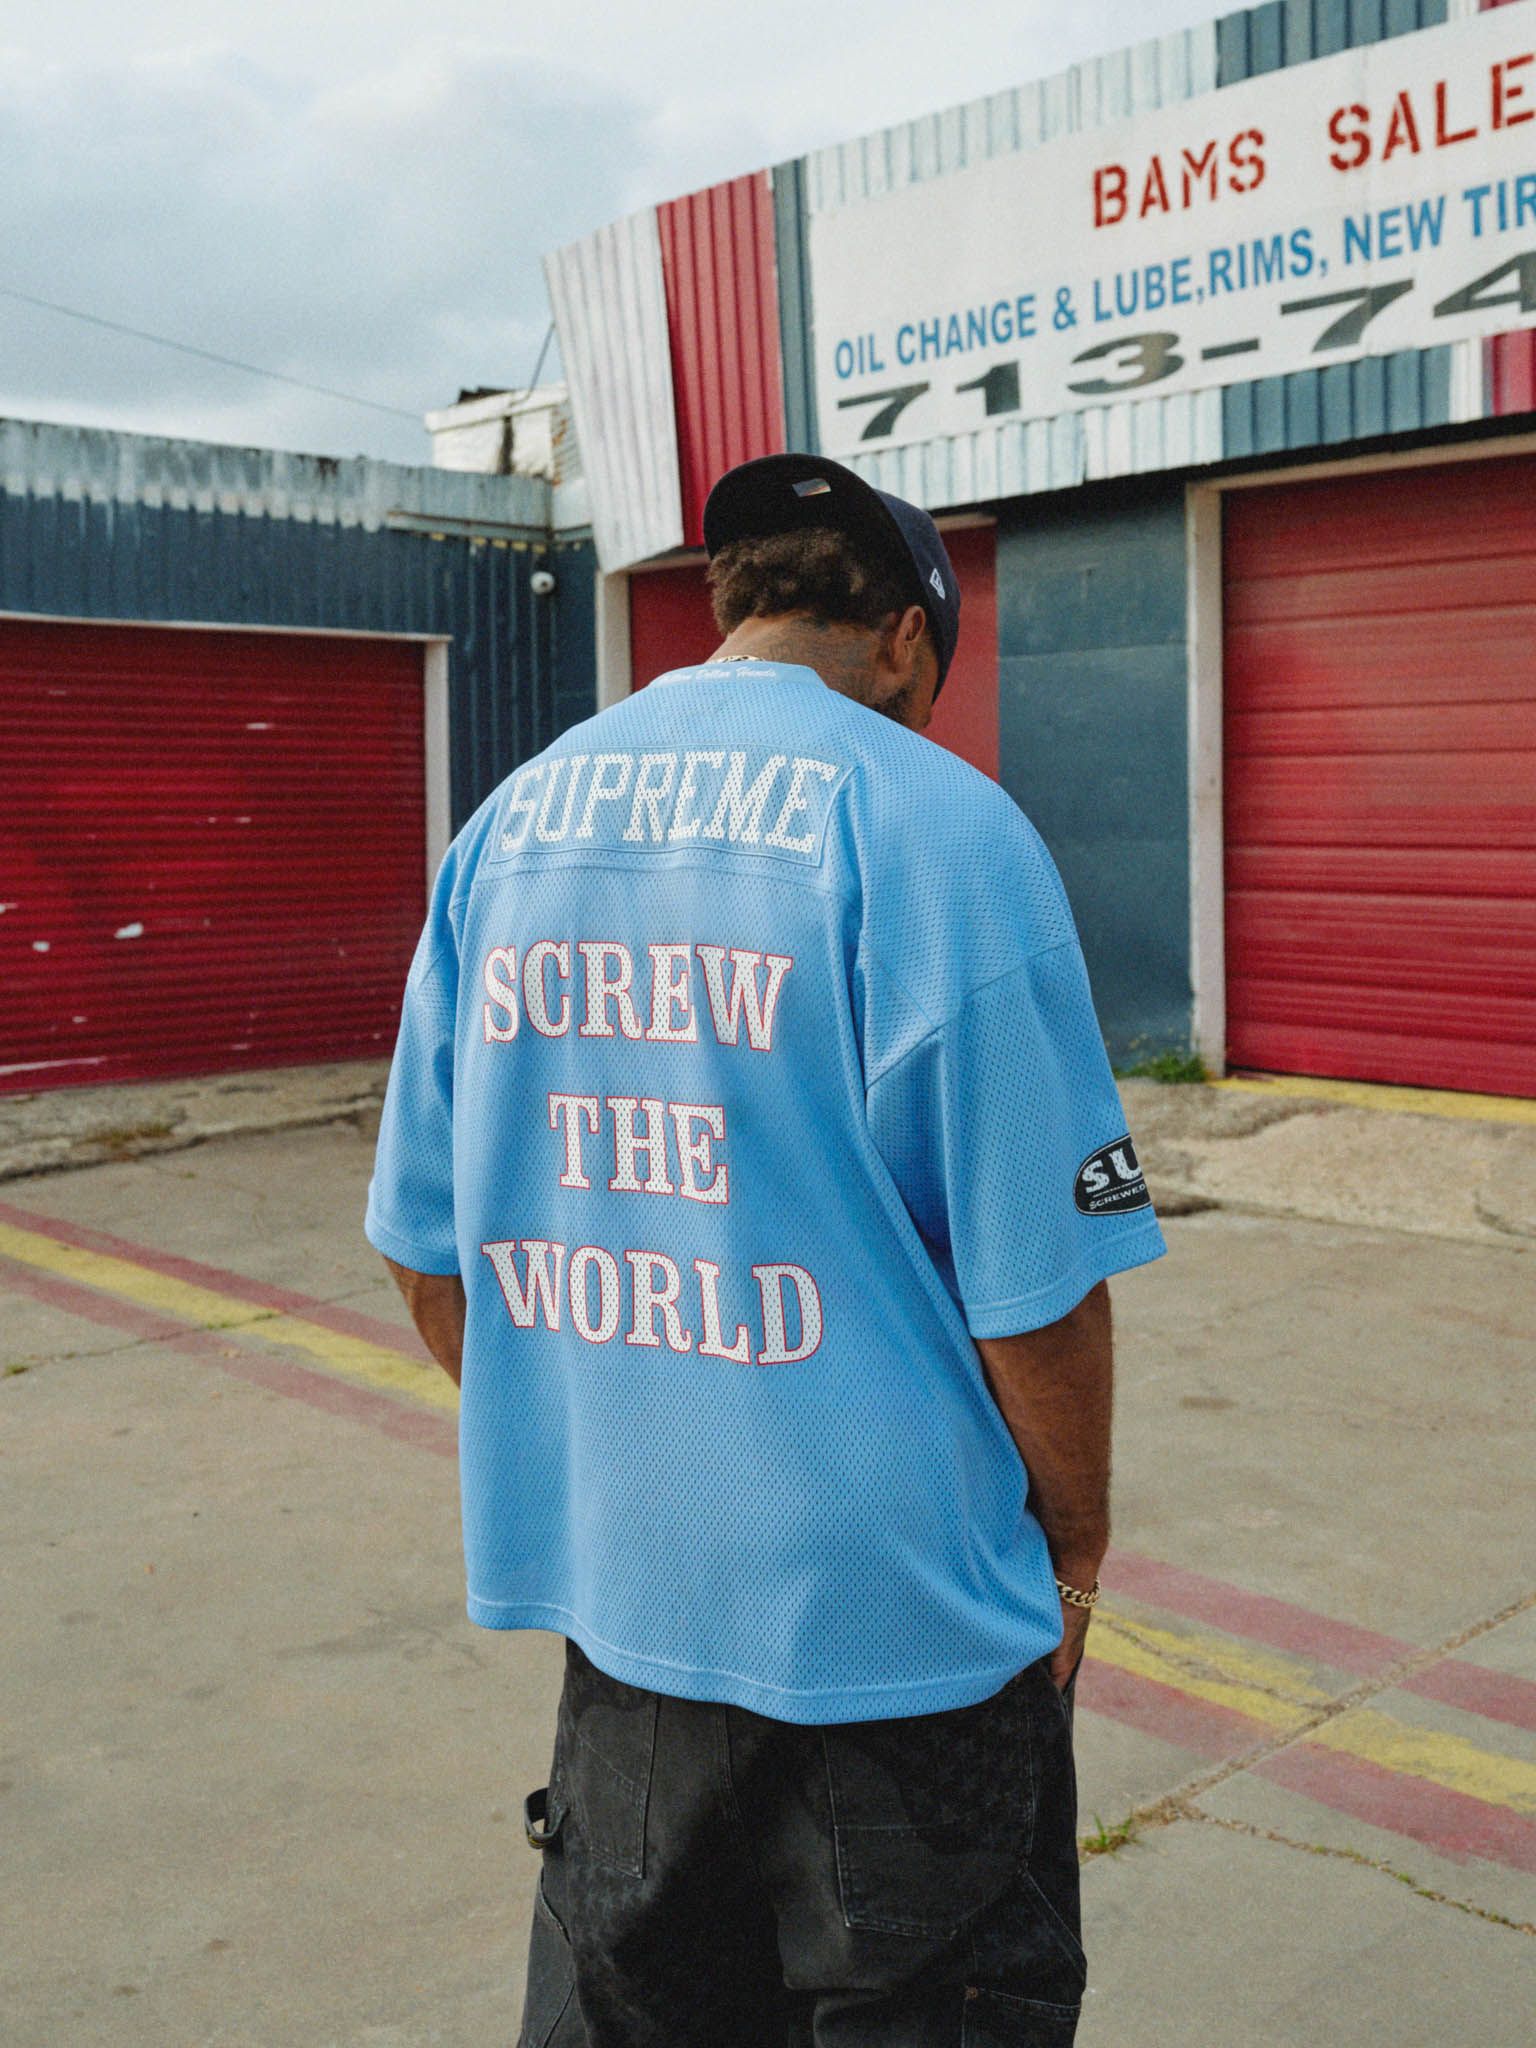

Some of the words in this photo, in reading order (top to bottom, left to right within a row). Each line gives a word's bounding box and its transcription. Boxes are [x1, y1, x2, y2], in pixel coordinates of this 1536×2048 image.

[1093, 128, 1266, 228] BAMS
[1328, 54, 1535, 171] SALE
[834, 339, 884, 380] OIL
[896, 294, 1036, 366] CHANGE
[1053, 286, 1097, 331] &
[1343, 195, 1446, 265] NEW
[837, 250, 1536, 441] 713-74
[501, 751, 839, 853] SUPREME
[483, 939, 794, 1052] SCREW
[548, 1093, 729, 1204] THE
[481, 1240, 823, 1366] WORLD
